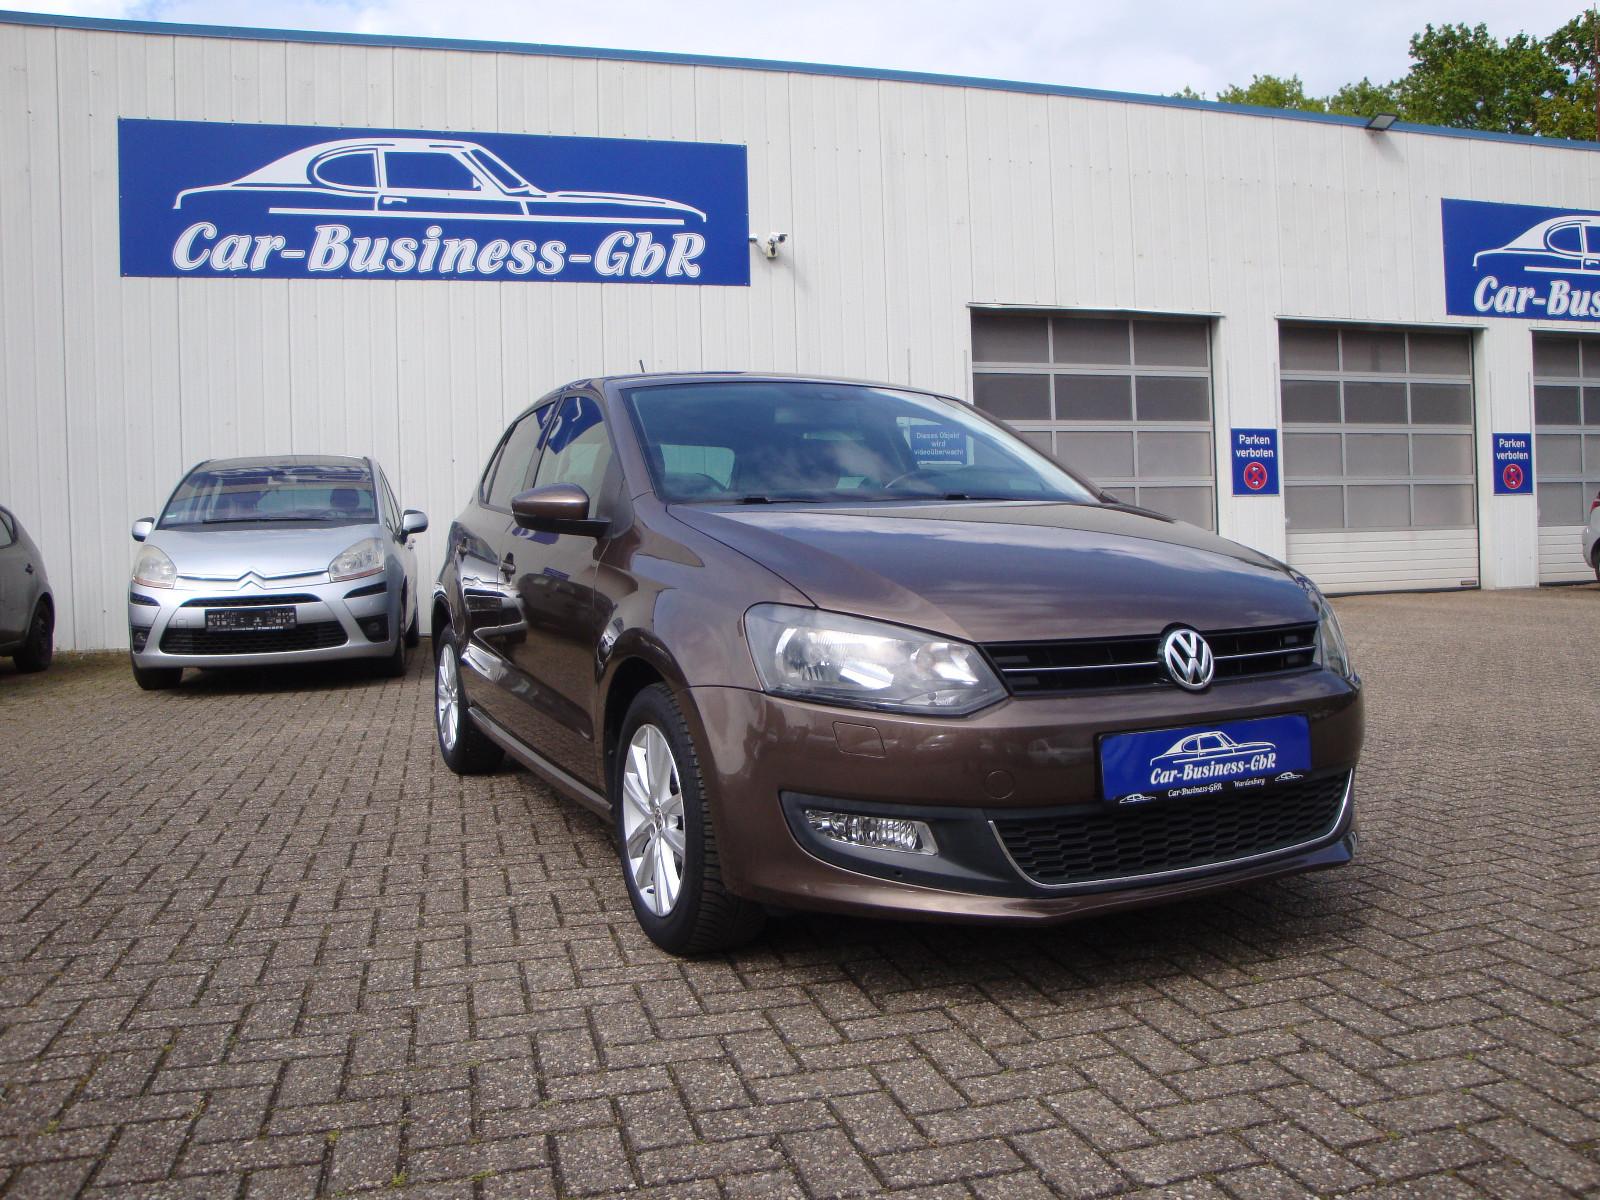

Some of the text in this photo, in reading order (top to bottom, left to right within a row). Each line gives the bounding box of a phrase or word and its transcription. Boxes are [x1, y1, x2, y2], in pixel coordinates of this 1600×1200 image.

[172, 222, 706, 279] Car-Business-GbR
[1239, 434, 1270, 445] Parken
[1499, 438, 1526, 448] Parken
[1235, 447, 1274, 458] verboten
[1496, 451, 1529, 460] verboten
[1150, 752, 1277, 785] Car-Business-GbR
[1167, 782, 1223, 798] Car-Business-GbR
